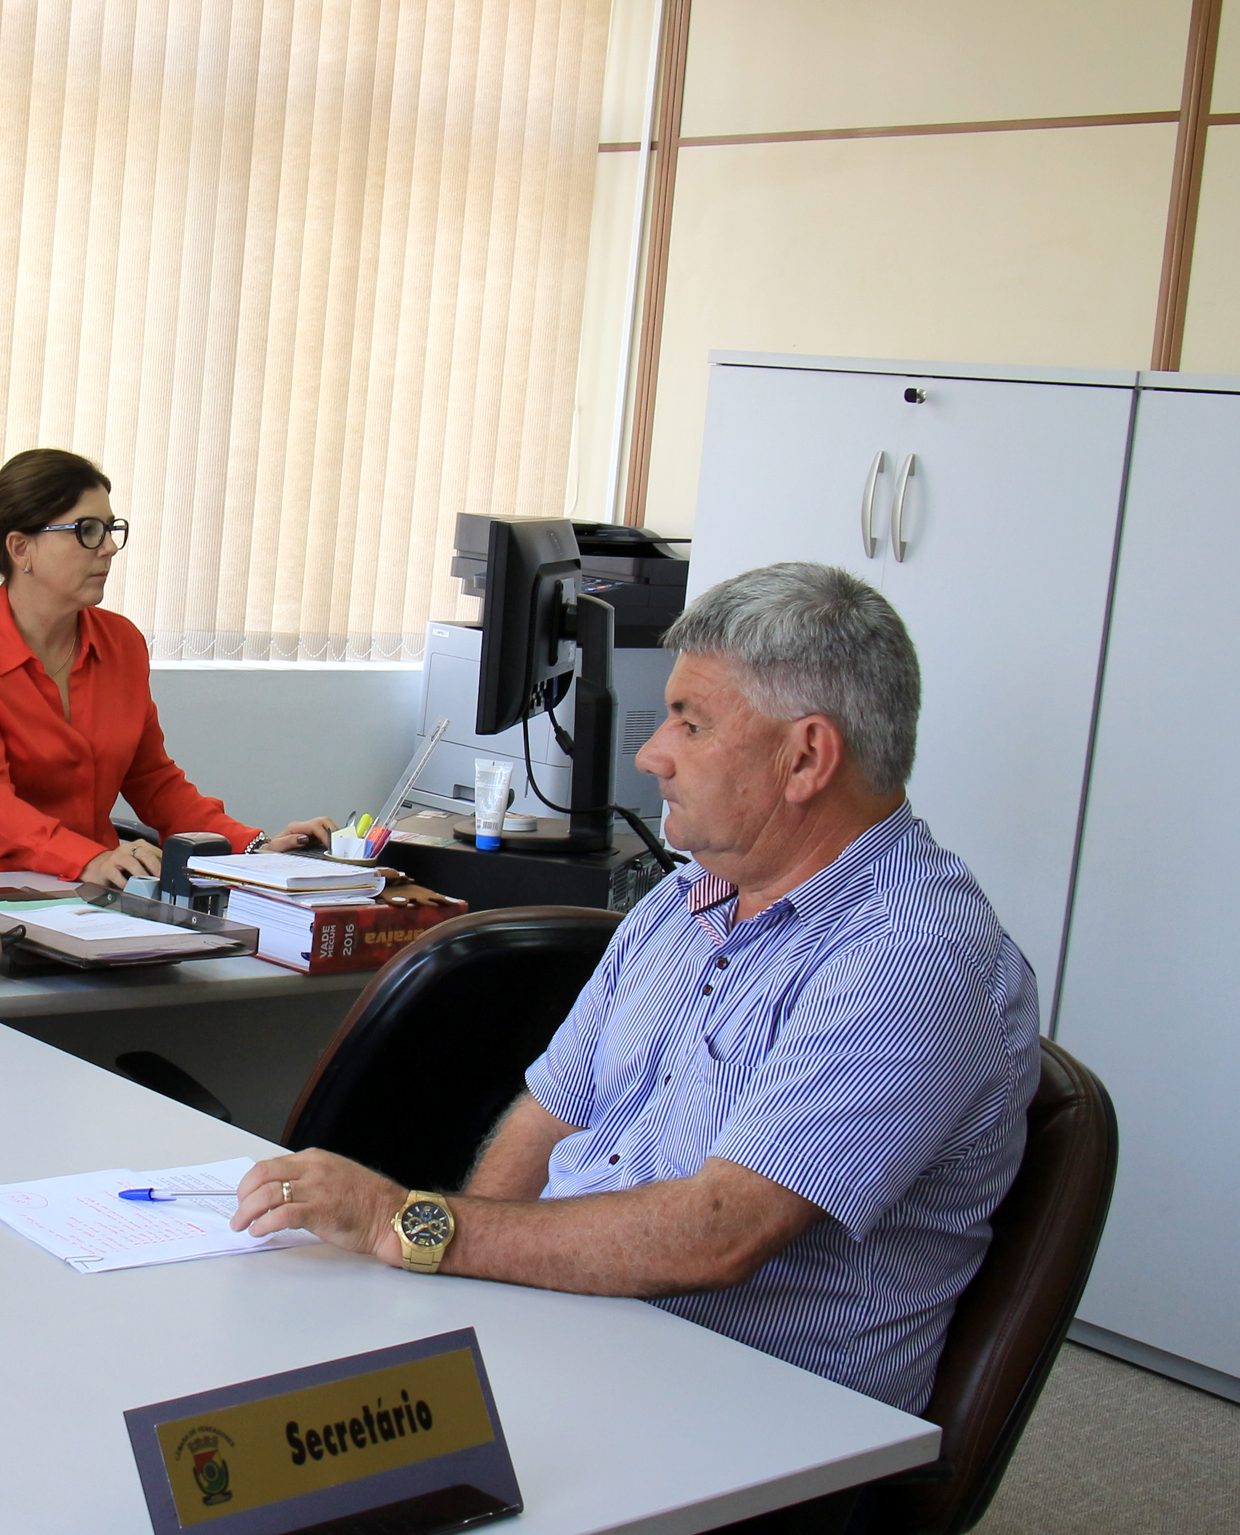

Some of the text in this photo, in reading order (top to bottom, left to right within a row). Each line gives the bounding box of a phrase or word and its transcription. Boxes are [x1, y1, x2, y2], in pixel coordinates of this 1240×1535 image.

[319, 925, 330, 958] VADE
[327, 925, 336, 958] MECUM
[343, 924, 355, 956] 2016
[285, 1389, 433, 1466] Secretário
